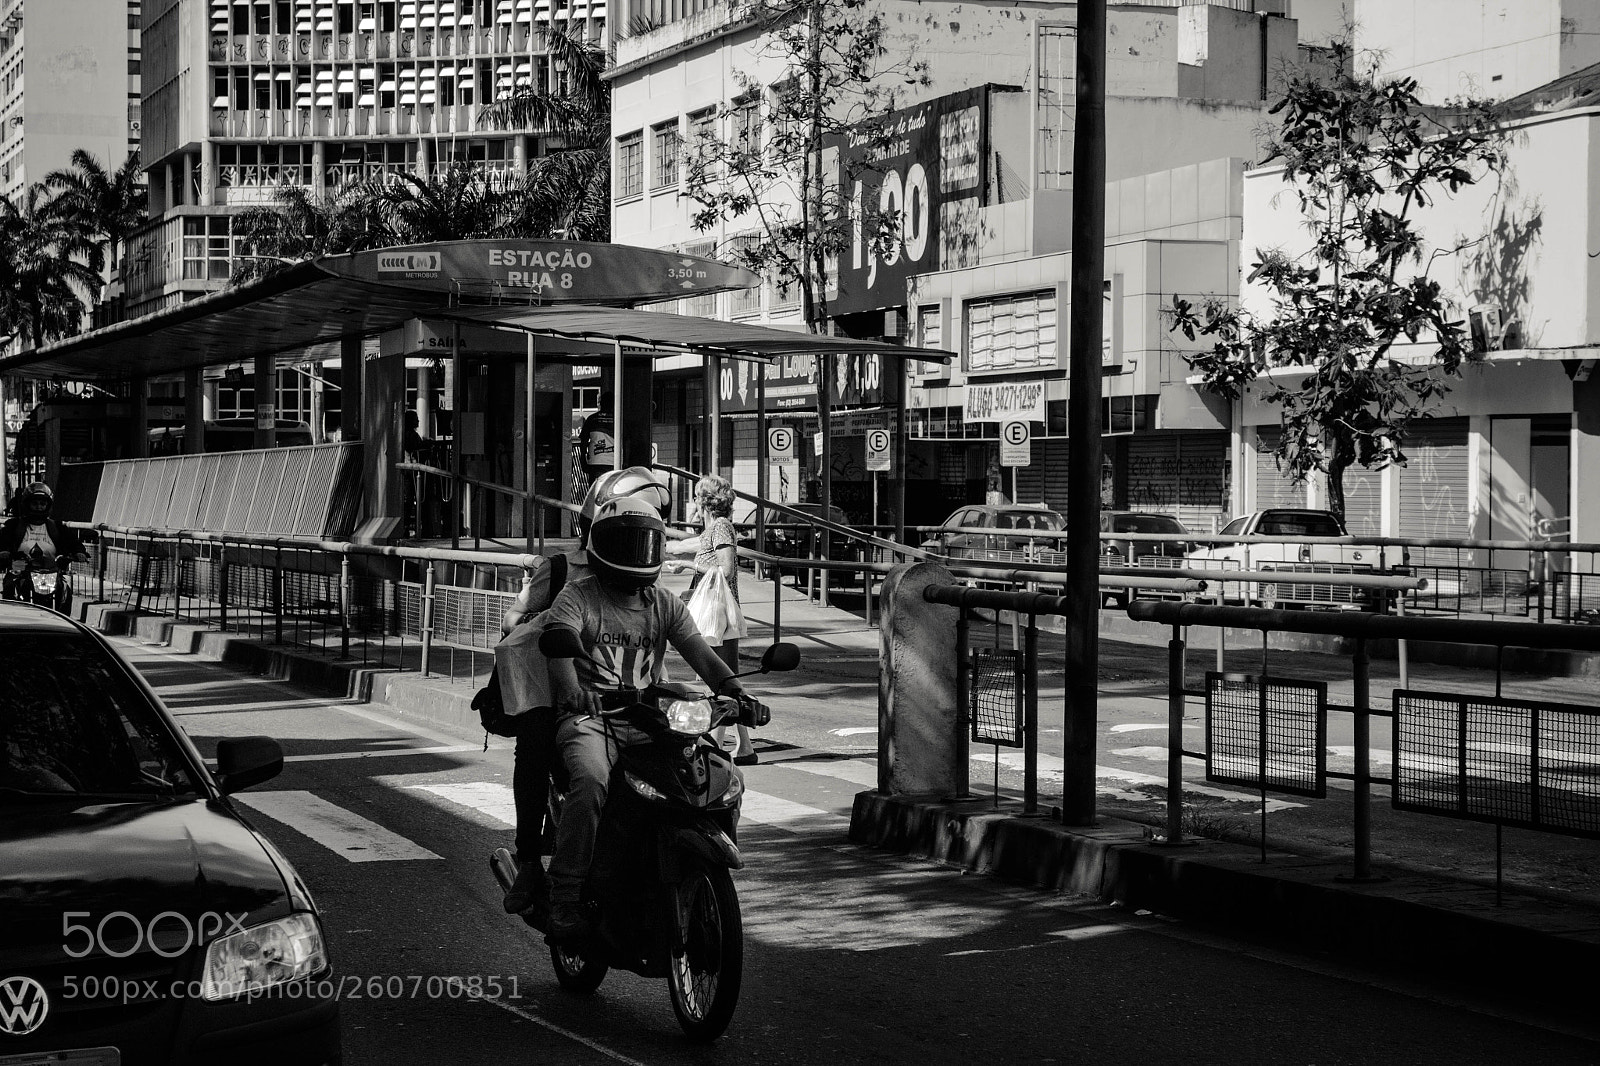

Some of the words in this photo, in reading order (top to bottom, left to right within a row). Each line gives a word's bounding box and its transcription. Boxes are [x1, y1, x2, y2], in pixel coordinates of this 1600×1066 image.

[900, 140, 910, 156] DE
[488, 248, 592, 271] ESTAÇÃO
[508, 271, 553, 288] RUA
[560, 272, 573, 289] 8
[668, 268, 693, 280] 3,50
[696, 270, 707, 278] m
[428, 335, 467, 348] SAÍA
[783, 354, 817, 384] Louç
[853, 353, 880, 397] 1,00
[720, 367, 733, 401] 00
[966, 386, 993, 419] ALUGO
[776, 433, 785, 447] E
[875, 434, 883, 448] E
[1012, 425, 1021, 441] E
[595, 633, 631, 646] JOHN
